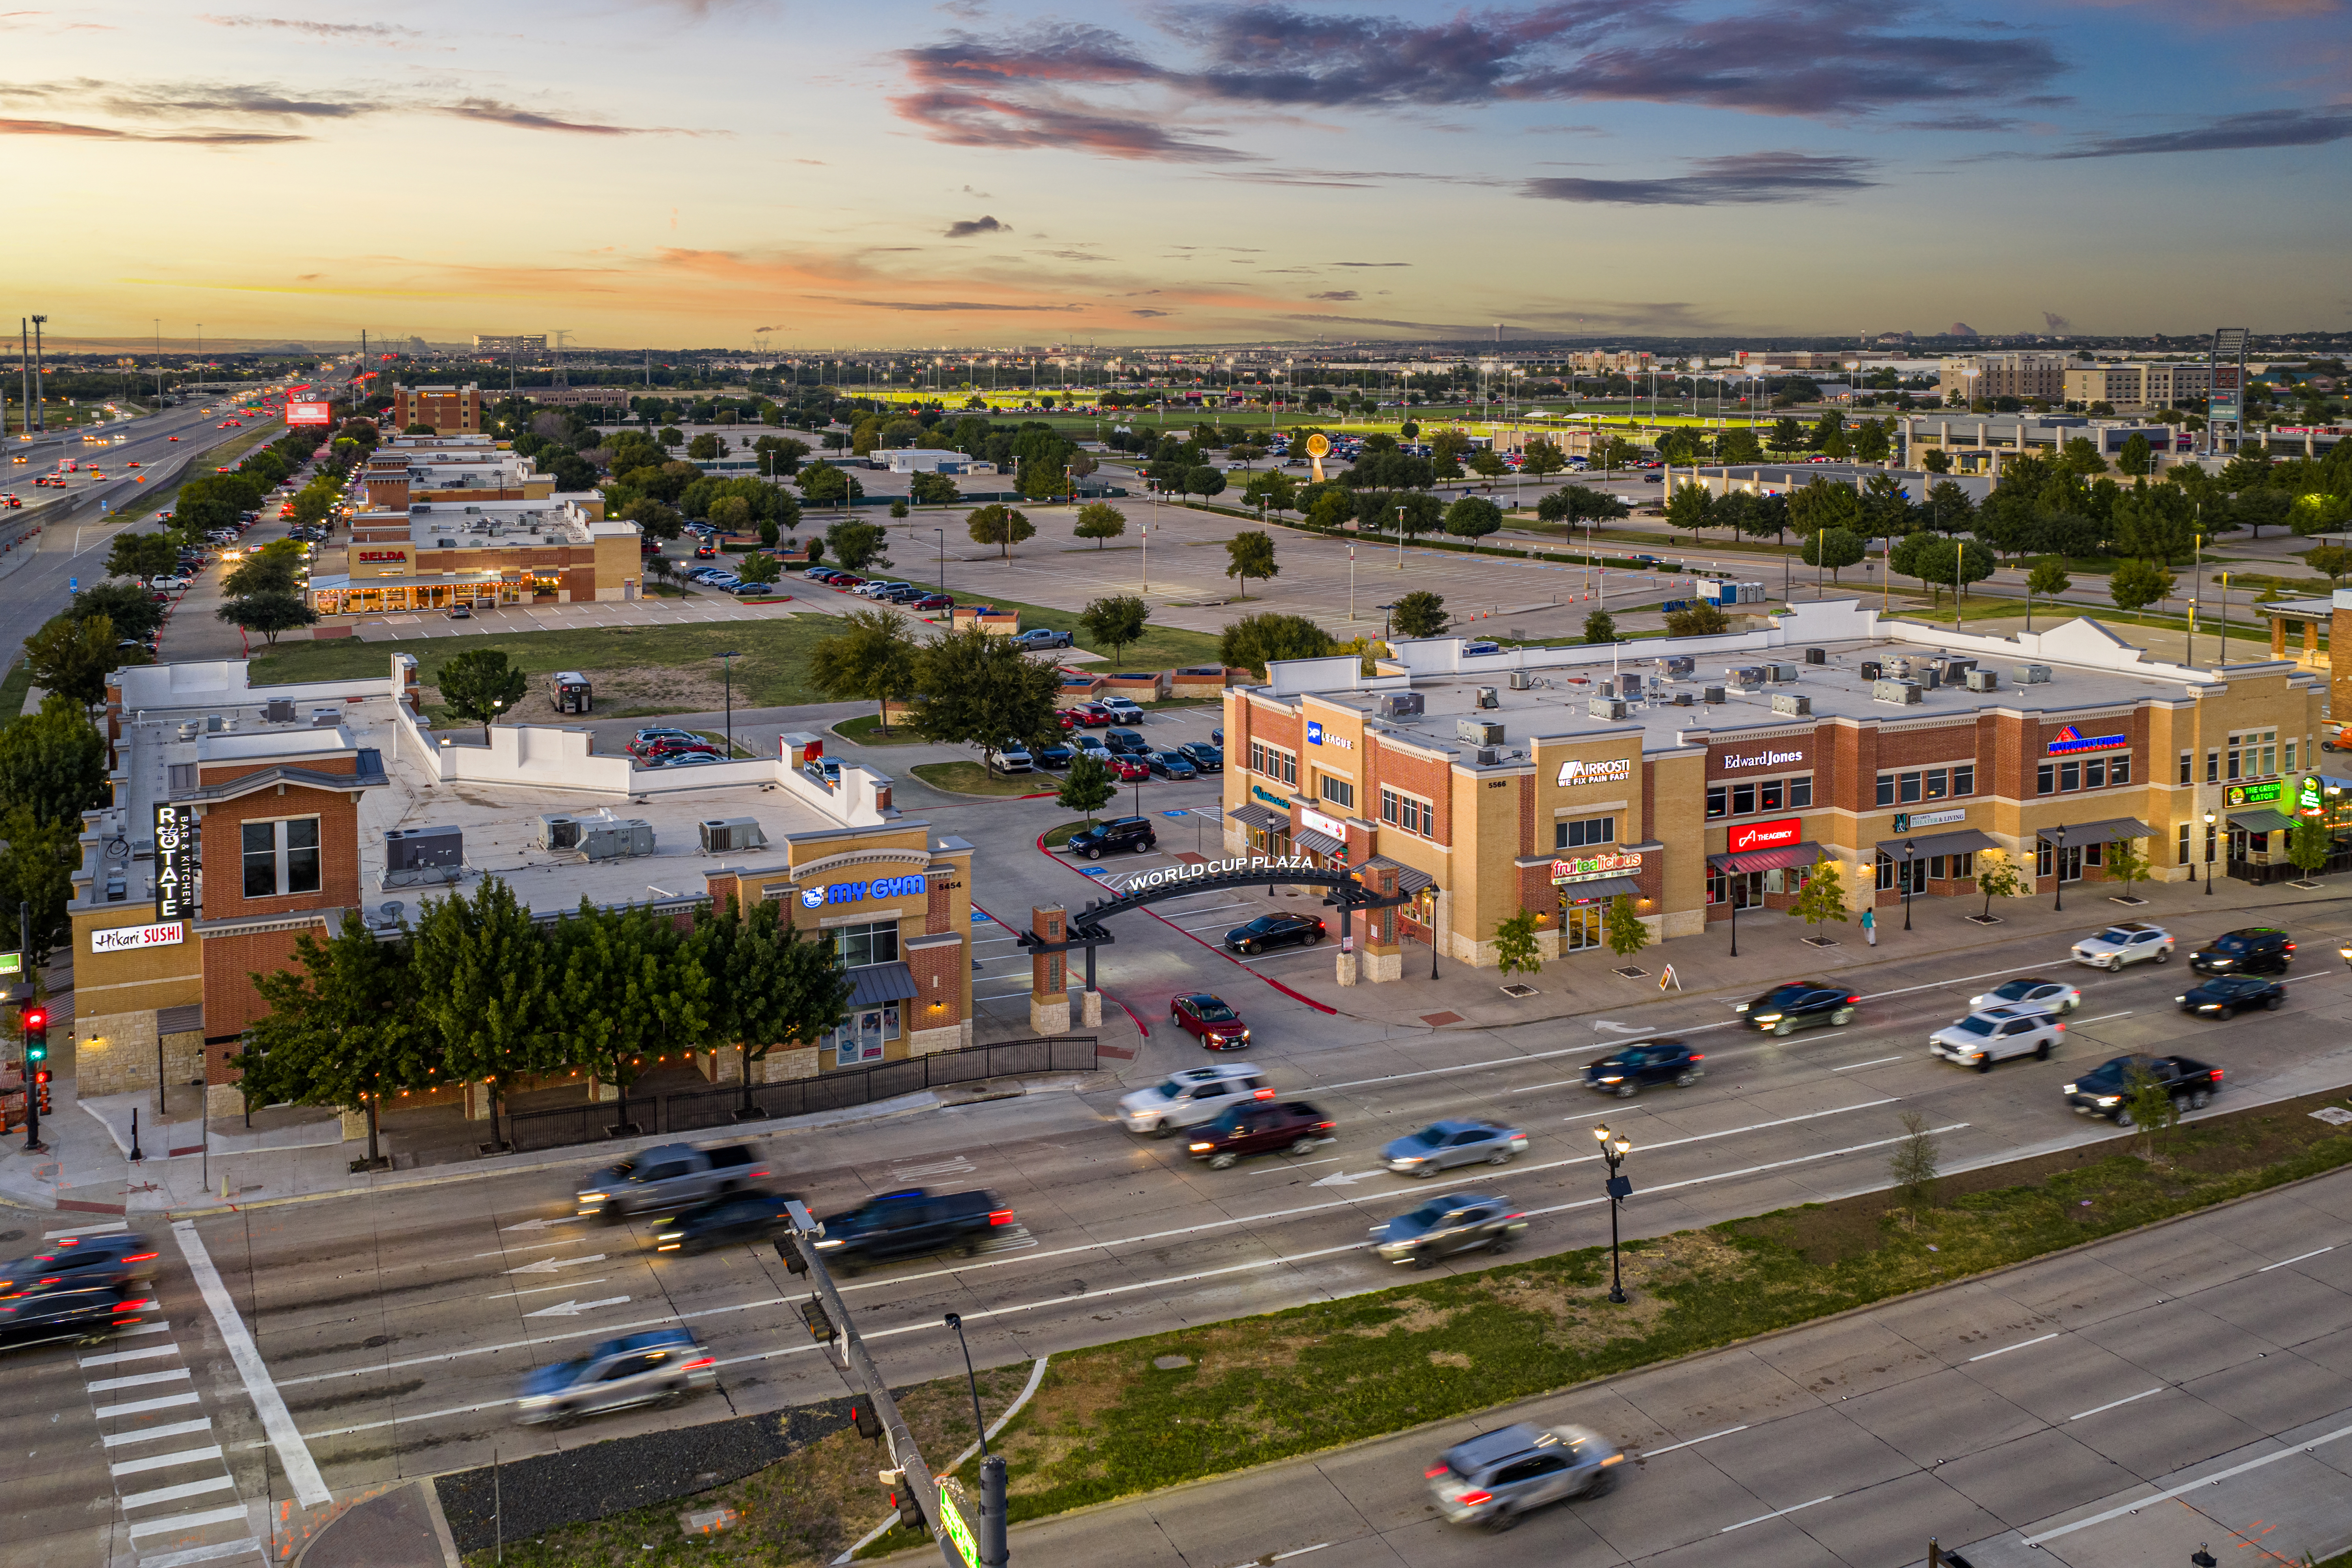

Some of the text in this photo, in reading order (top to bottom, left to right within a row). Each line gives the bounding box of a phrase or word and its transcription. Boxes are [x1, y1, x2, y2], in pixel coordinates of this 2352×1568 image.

[359, 551, 406, 560] SELDA
[1321, 732, 1351, 750] LEAGUE
[2050, 735, 2125, 751] INTEGRITY FIRST
[1573, 759, 1630, 776] AIRROSTI
[1588, 775, 1607, 783] PAIN
[1610, 772, 1629, 781] FAST
[2259, 783, 2281, 792] GREEN
[1263, 792, 1289, 809] Miracle-Ear
[2251, 792, 2274, 801] GATOR
[180, 816, 189, 838] BAR
[1911, 818, 1938, 826] THEATER
[160, 807, 179, 916] ROTATE
[1554, 853, 1640, 875] fruitealicious
[181, 855, 191, 905] KITCHEN
[1128, 855, 1314, 891] WORLD CUP PLAZA
[828, 874, 925, 904] MY GYM
[939, 881, 961, 890] 5454
[95, 926, 180, 949] Hikari SUSHI
[945, 1494, 961, 1533] Dallas
